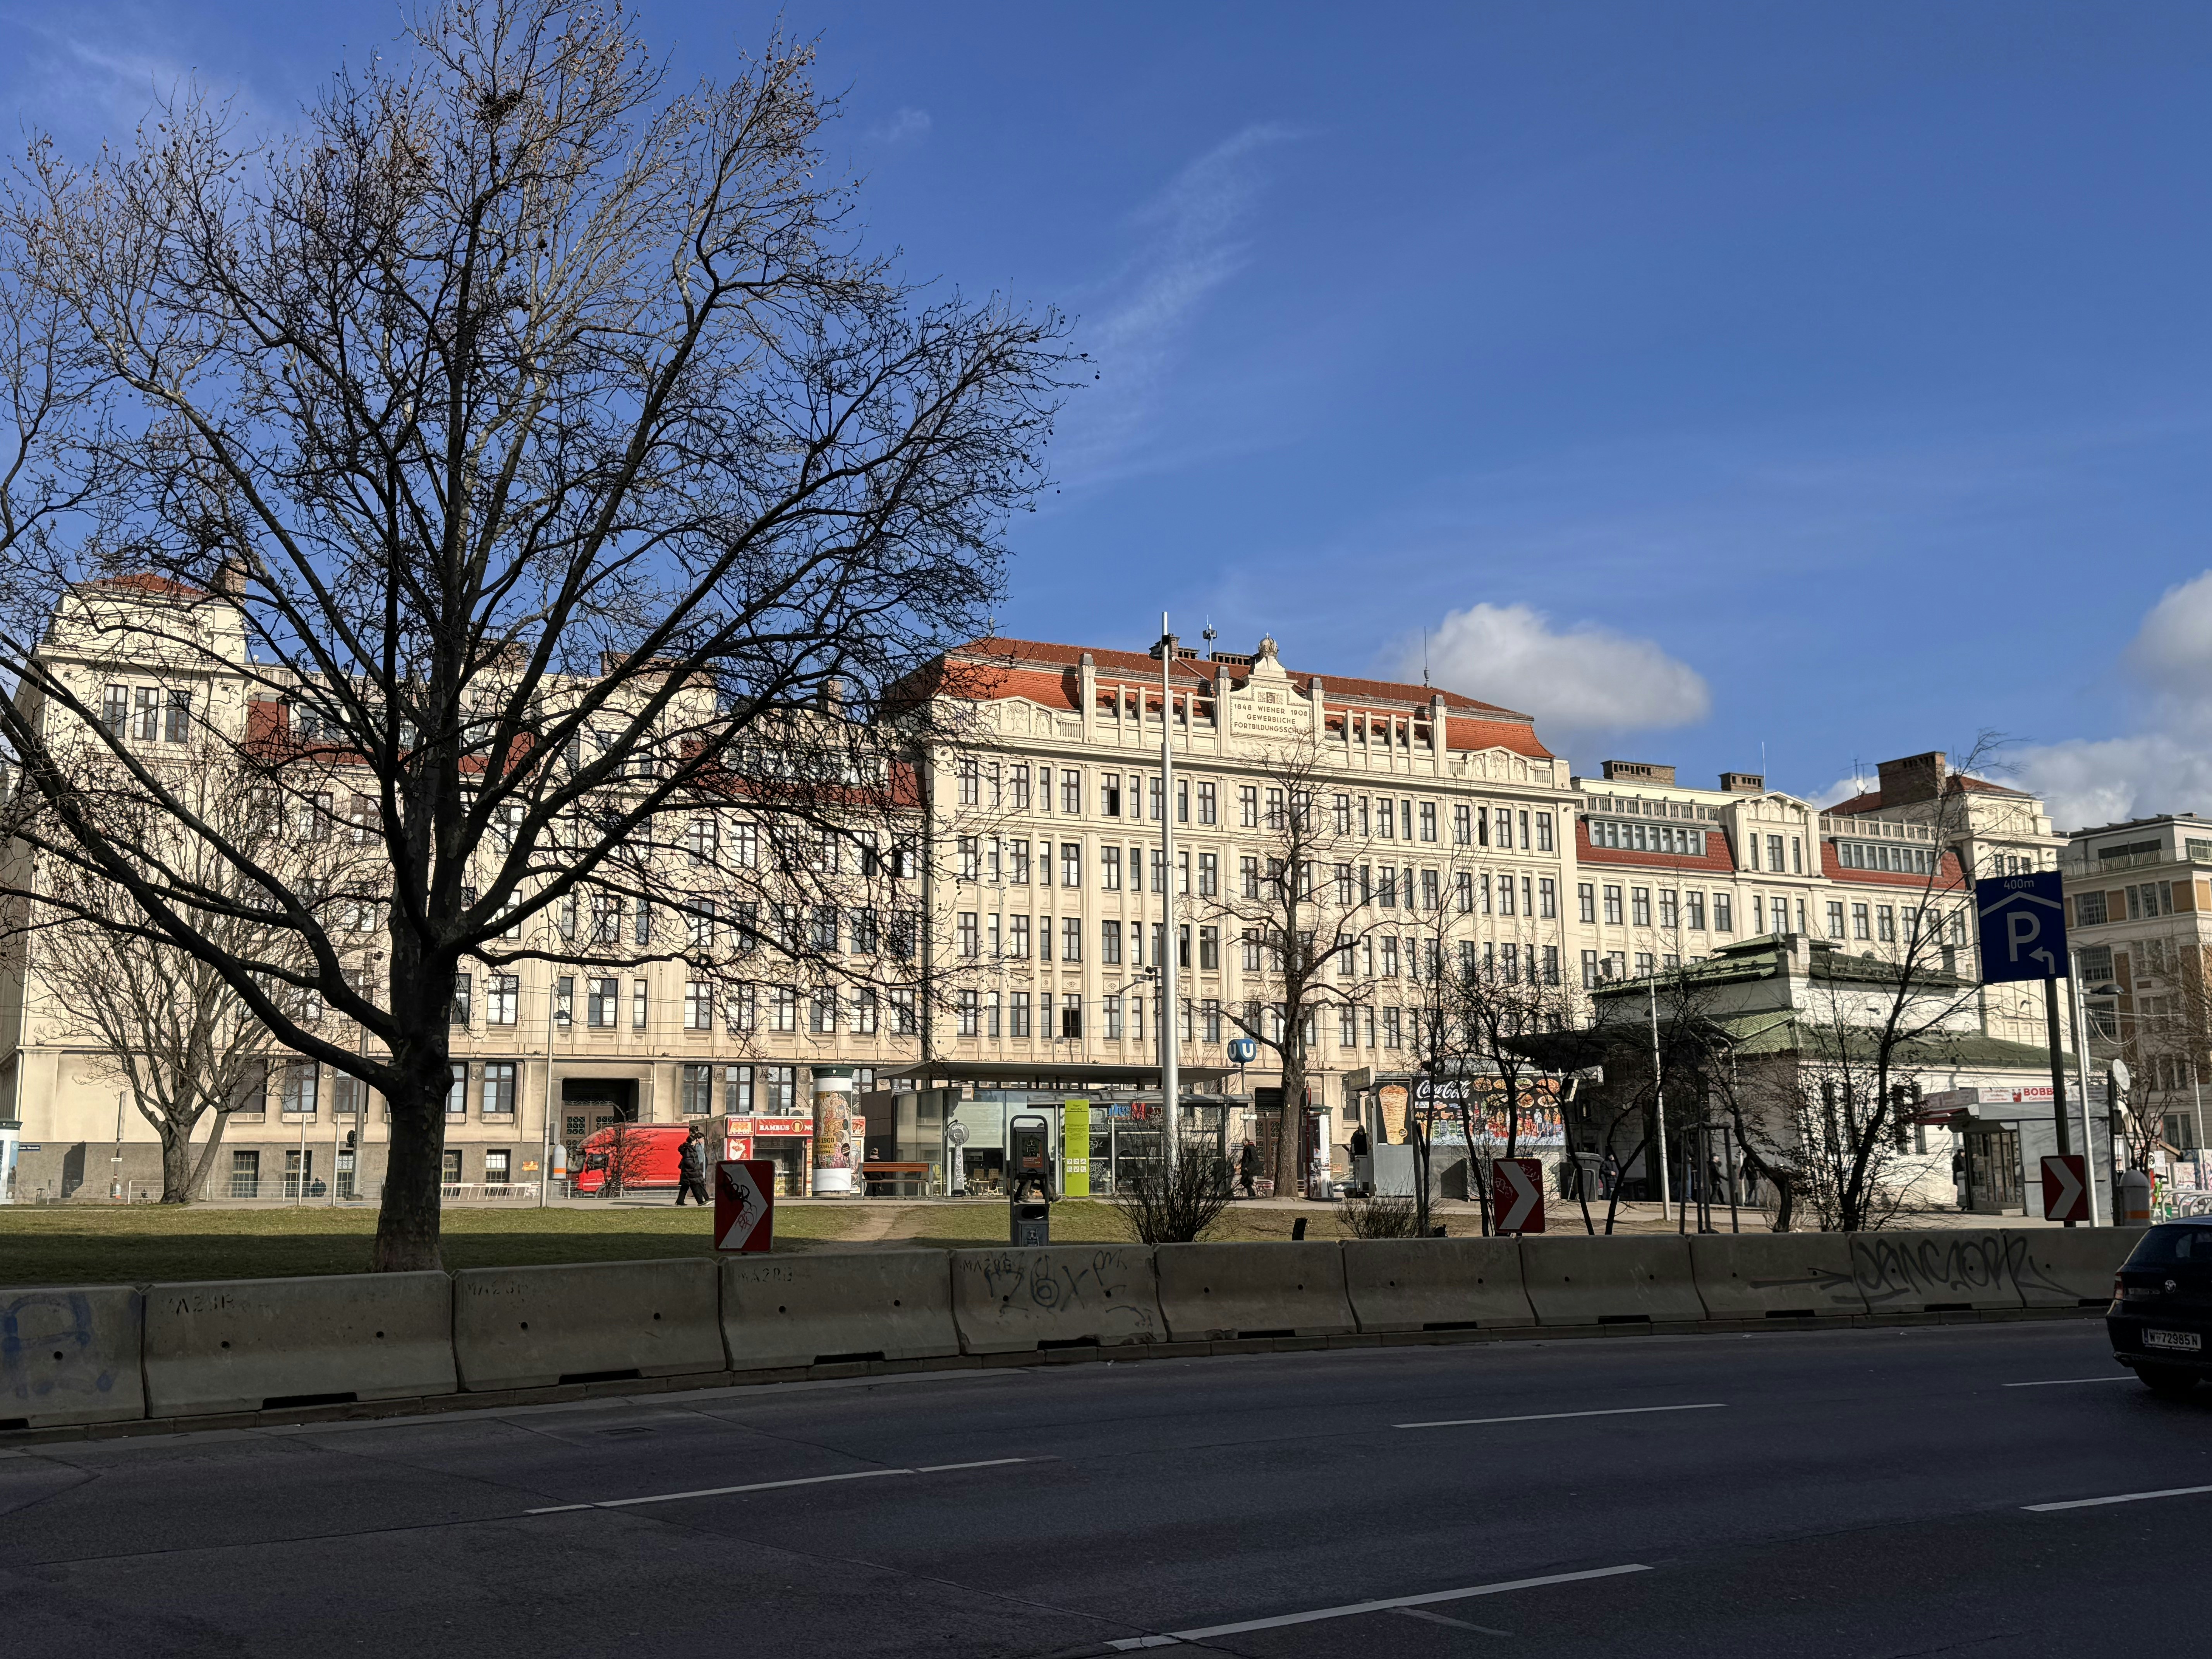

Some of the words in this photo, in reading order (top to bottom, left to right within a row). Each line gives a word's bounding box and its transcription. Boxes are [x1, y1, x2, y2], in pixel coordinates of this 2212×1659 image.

[1258, 706, 1285, 714] WIENER
[1247, 714, 1296, 725] GEWERBLICHE
[1234, 722, 1308, 734] FORTBILDUNGSSCHULE
[2004, 879, 2034, 890] 400m
[2007, 911, 2040, 962] P
[1229, 1044, 1237, 1059] U
[1242, 1043, 1254, 1058] U
